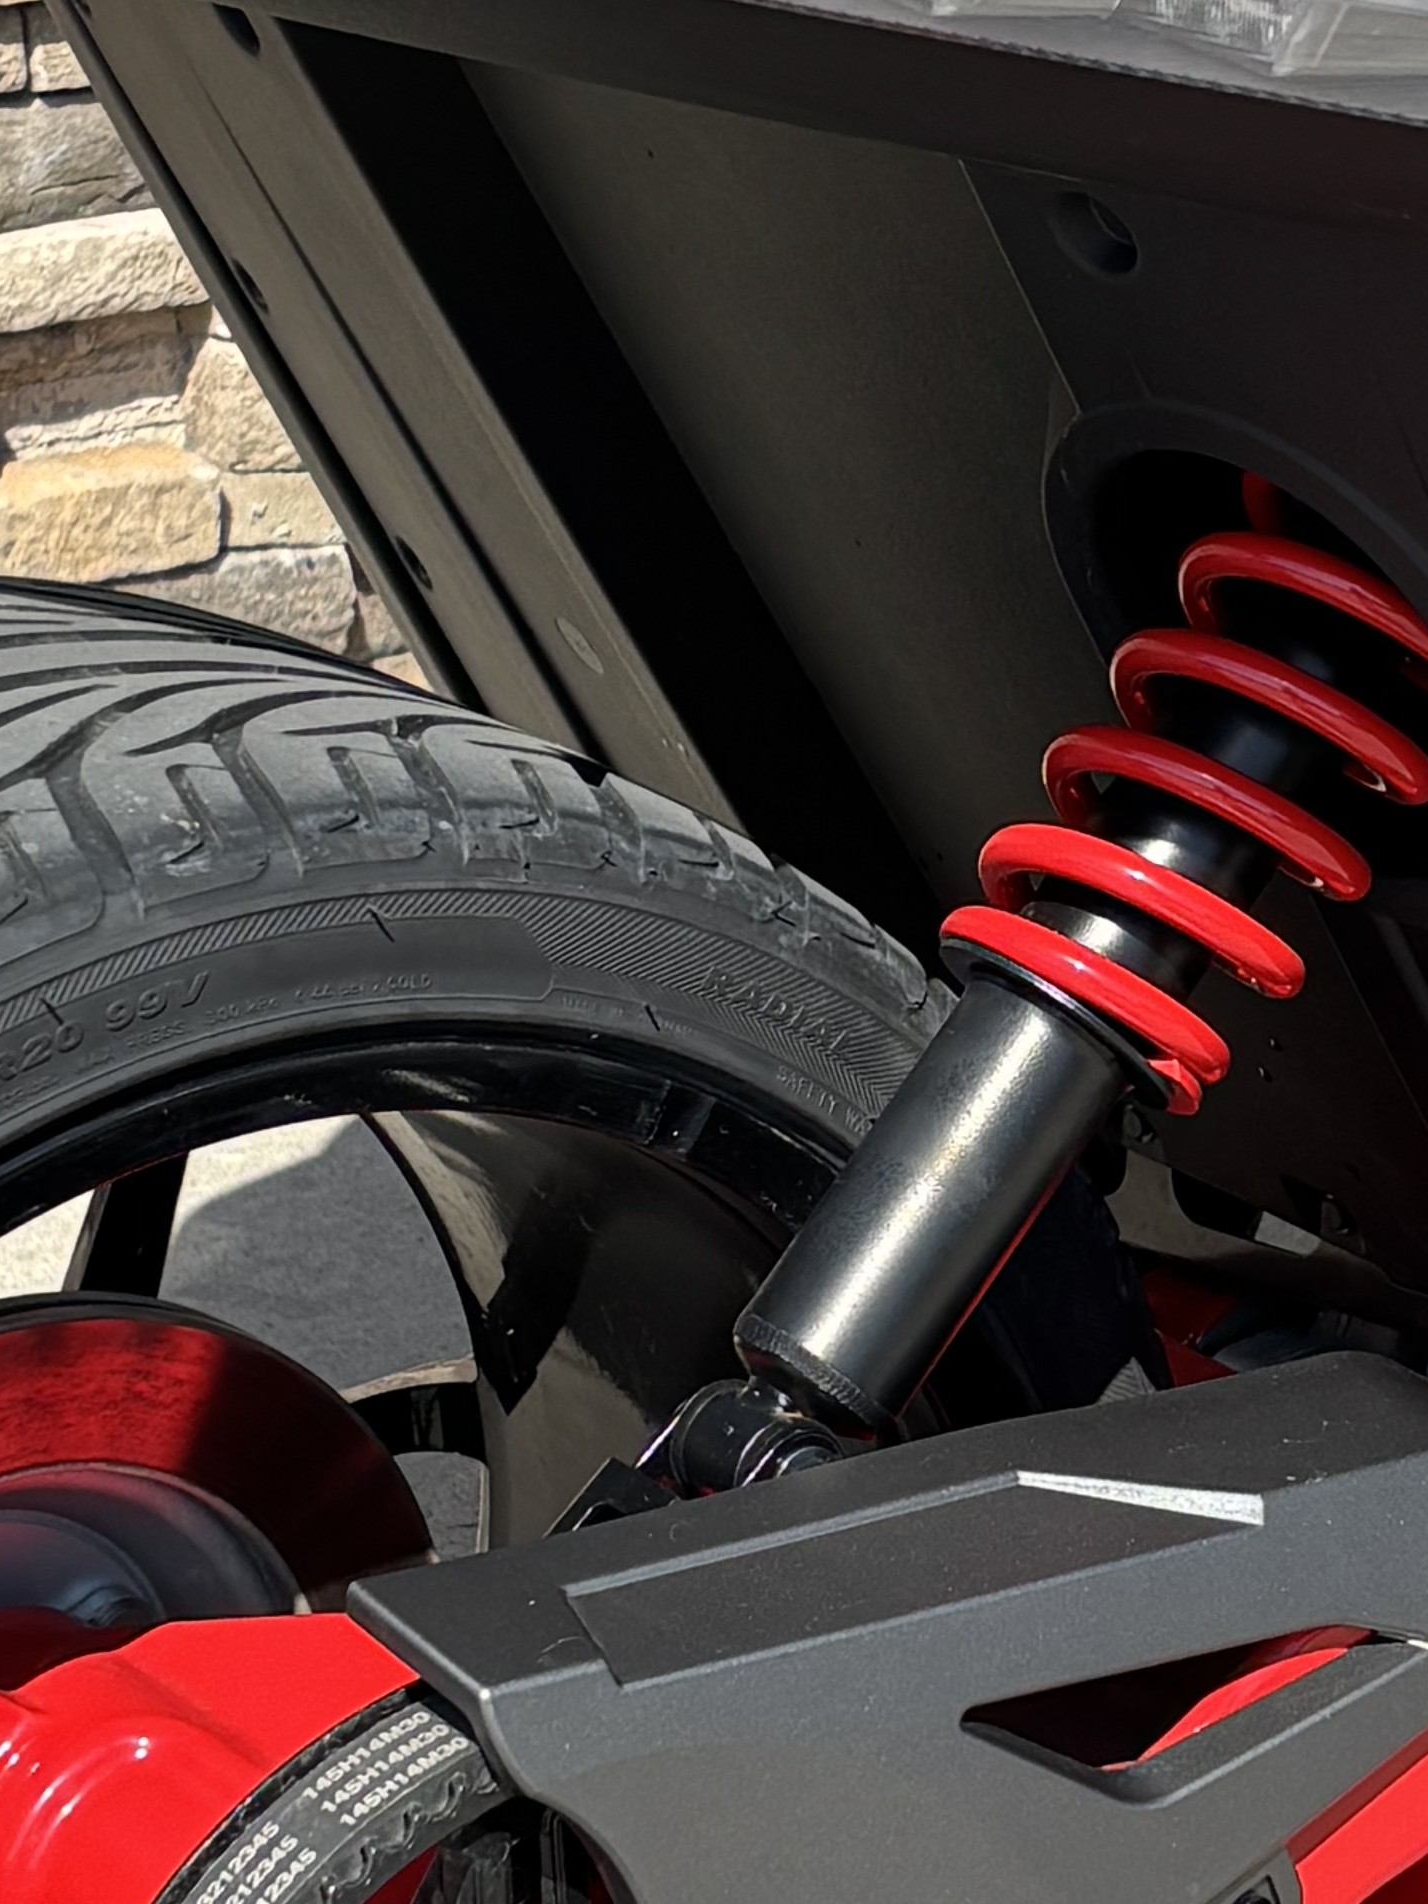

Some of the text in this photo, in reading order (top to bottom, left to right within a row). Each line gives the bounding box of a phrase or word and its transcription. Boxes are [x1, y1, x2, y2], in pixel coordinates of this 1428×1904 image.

[700, 964, 853, 1053] RADIAL
[303, 1711, 431, 1799] 145H14M30
[321, 1724, 450, 1813] 145H14M30
[340, 1736, 470, 1826] 145H14M30
